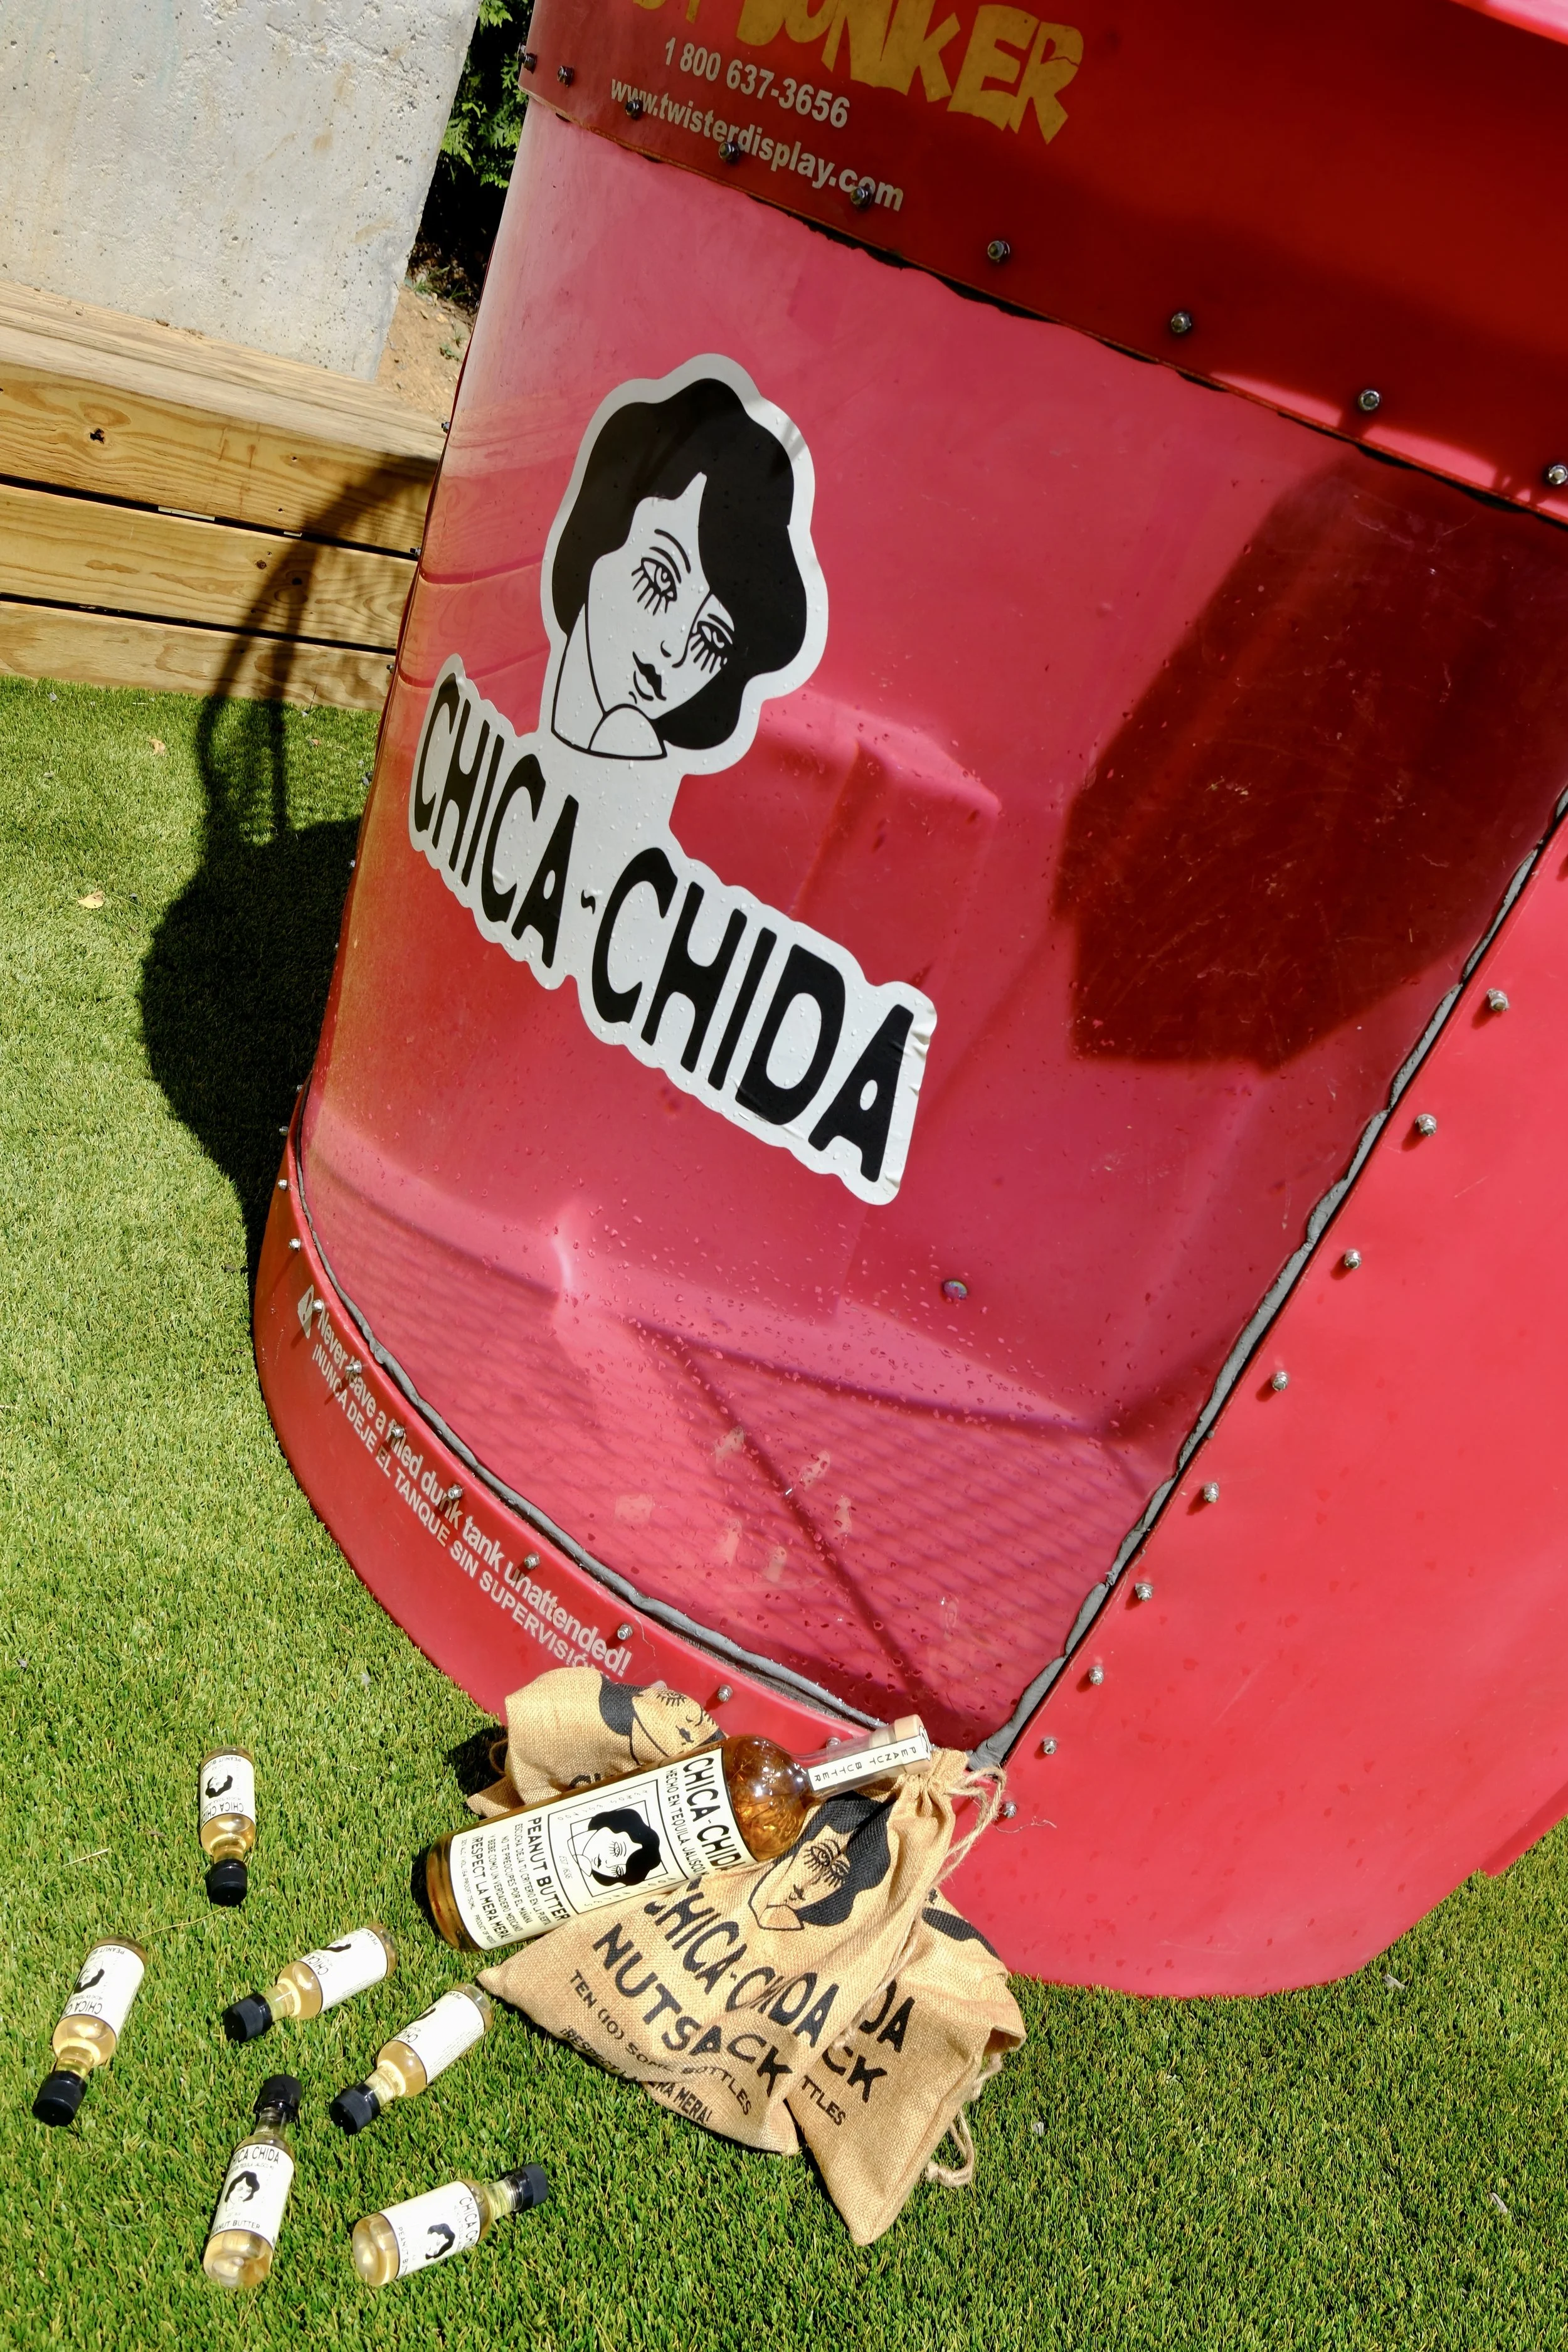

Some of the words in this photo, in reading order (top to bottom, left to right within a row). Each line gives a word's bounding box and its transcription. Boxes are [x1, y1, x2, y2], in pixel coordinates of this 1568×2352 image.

[665, 37, 676, 66] 1
[680, 43, 721, 82] 800
[726, 59, 850, 129] 637-3656
[611, 78, 904, 212] www.twisterdisplay.com
[317, 1305, 349, 1369] Never
[376, 1411, 386, 1434] a
[420, 1469, 459, 1530] dunk
[462, 1515, 506, 1572] tank
[504, 1559, 633, 1677] unattended!
[346, 1401, 378, 1454] DEJE
[376, 1444, 392, 1478] EL
[395, 1466, 449, 1547] TANQUE
[449, 1540, 479, 1579] SIN
[869, 1745, 917, 1766] PEANUT
[665, 1767, 679, 1794] HECHO
[813, 1761, 862, 1782] BUTTER
[219, 1801, 245, 1813] CHICA
[667, 1794, 680, 1807] EN
[514, 1823, 524, 1847] ESCUCHA
[670, 1807, 691, 1846] TEQUILA
[487, 1838, 497, 1855] BEBE
[501, 1835, 510, 1844] NO
[501, 1843, 510, 1853] TE
[527, 1816, 548, 1871] PEANUT
[488, 1854, 499, 1871] COMO
[516, 1848, 525, 1865] DEJA
[490, 1870, 500, 1881] UN
[502, 1851, 517, 1888] PREOCUPES
[519, 1863, 527, 1873] TU
[475, 1880, 490, 1896] LA
[492, 1880, 512, 1913] VERDADERO
[511, 1887, 521, 1900] POR
[520, 1873, 537, 1899] CRITERIO
[479, 1895, 499, 1922] MERA
[514, 1899, 524, 1908] EL
[529, 1895, 540, 1907] EN
[533, 1904, 543, 1914] LA
[536, 1875, 571, 1922] BUTTER
[99, 1946, 125, 1955] PEANUT
[74, 2001, 103, 2015] CHICA
[569, 1969, 598, 2009] TEN
[597, 2008, 625, 2040] (10)
[593, 1921, 793, 2098] NUTSACK
[801, 2074, 847, 2126] TTLES
[252, 2146, 280, 2164] CHIDA
[459, 2196, 478, 2229] CHICA
[232, 2220, 261, 2230] BUTTER
